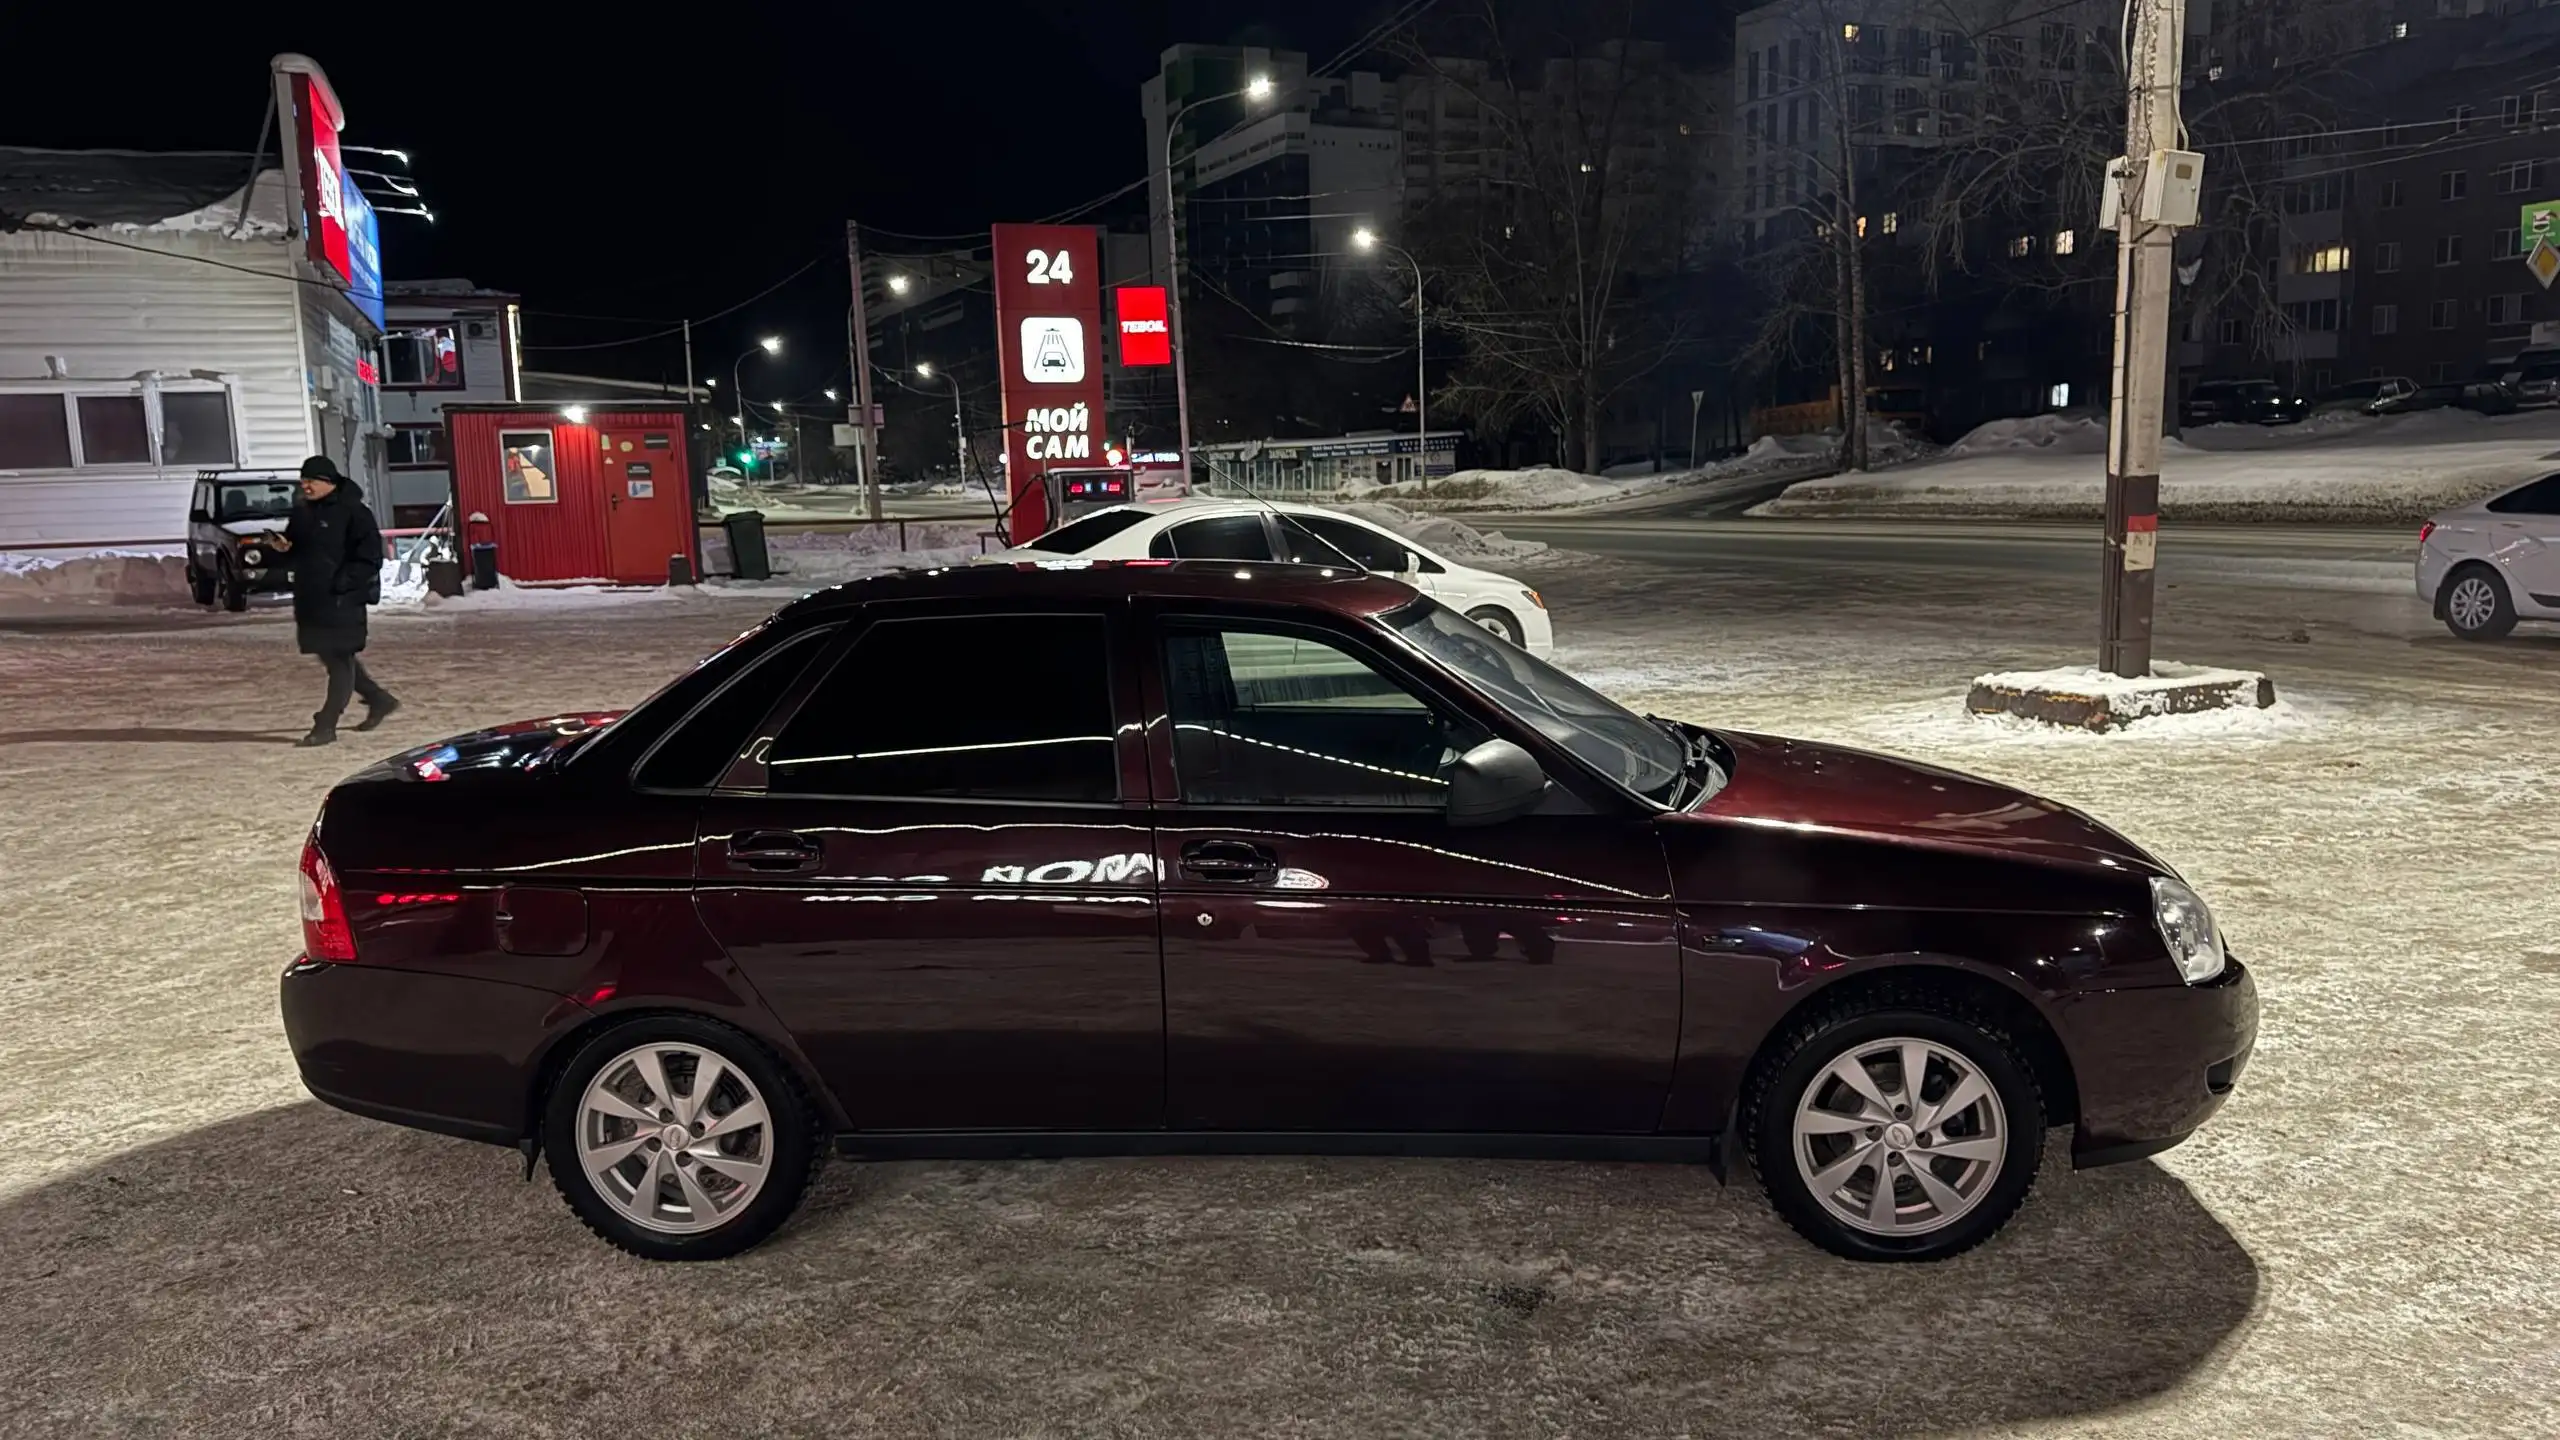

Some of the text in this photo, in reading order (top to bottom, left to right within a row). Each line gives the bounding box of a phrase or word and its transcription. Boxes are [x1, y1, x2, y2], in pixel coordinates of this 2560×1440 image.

[1025, 248, 1073, 284] 24
[1024, 401, 1089, 433] МОЙ
[1025, 434, 1090, 460] САМ
